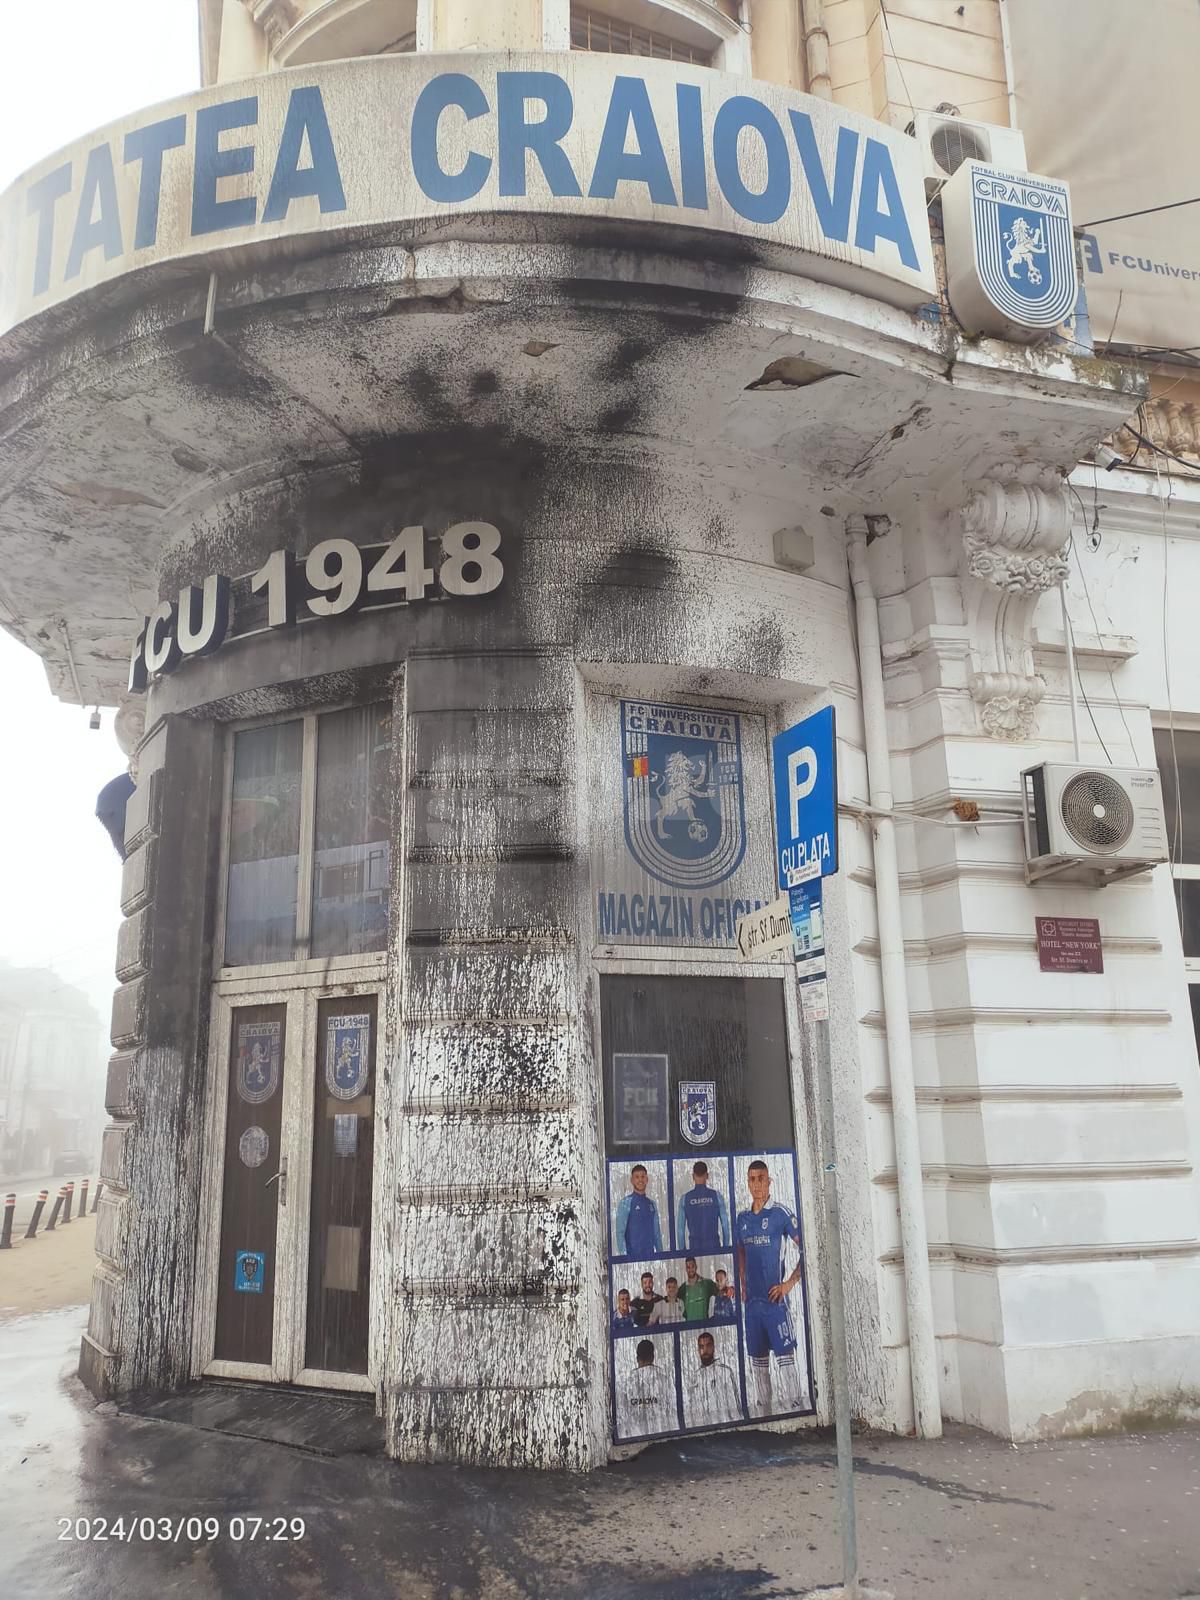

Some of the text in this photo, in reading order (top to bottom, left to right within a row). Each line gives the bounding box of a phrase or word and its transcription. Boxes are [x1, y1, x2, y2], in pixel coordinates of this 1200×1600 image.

[411, 71, 921, 272] CRAIOVA
[971, 165, 1066, 193] FOTBAL CLUB UNIVERSITATEA
[976, 179, 1066, 216] CRAIOVA
[1108, 251, 1200, 281] FCUniver
[250, 521, 505, 628] 1948
[630, 705, 730, 726] FC UNIVERSITATEA
[630, 716, 732, 740] CRAIOVA
[787, 745, 818, 840] P
[781, 845, 795, 874] CU
[797, 831, 831, 869] PLATA
[598, 892, 694, 938] MAGAZIN
[748, 925, 760, 949] str.
[760, 917, 770, 943] Sf.
[1041, 940, 1061, 948] HOTEL
[240, 1027, 279, 1036] CRAIOVA
